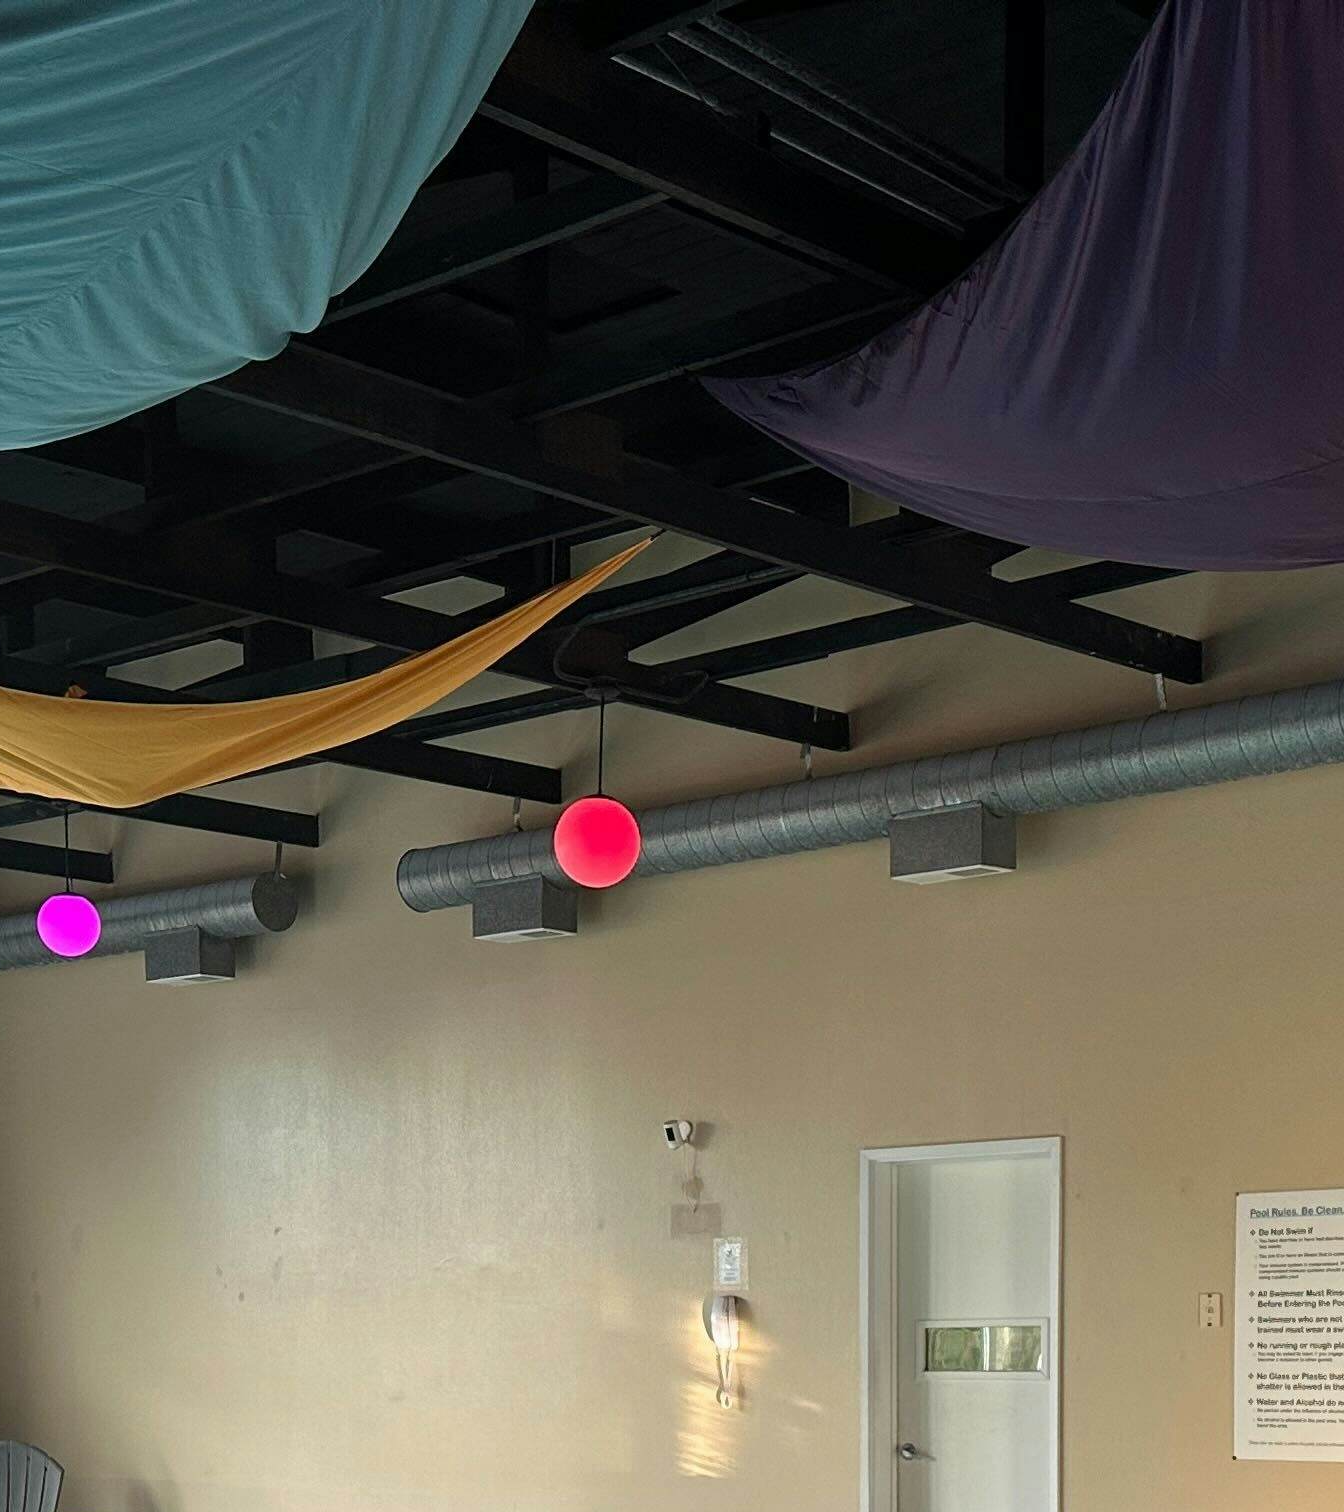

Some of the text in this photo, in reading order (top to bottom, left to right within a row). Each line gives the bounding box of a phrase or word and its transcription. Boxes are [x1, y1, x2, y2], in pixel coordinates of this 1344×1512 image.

[1250, 1208, 1270, 1218] Pool
[1302, 1206, 1314, 1215] Be
[1258, 1228, 1269, 1236] Do
[1271, 1228, 1284, 1236] Not
[1286, 1228, 1307, 1236] Swim
[1258, 1289, 1268, 1297] All
[1306, 1289, 1325, 1297] Must
[1258, 1299, 1283, 1308] Before
[1285, 1299, 1317, 1308] Entering
[1318, 1299, 1331, 1308] the
[1298, 1315, 1314, 1323] who
[1269, 1342, 1298, 1350] running
[1310, 1342, 1332, 1350] rough
